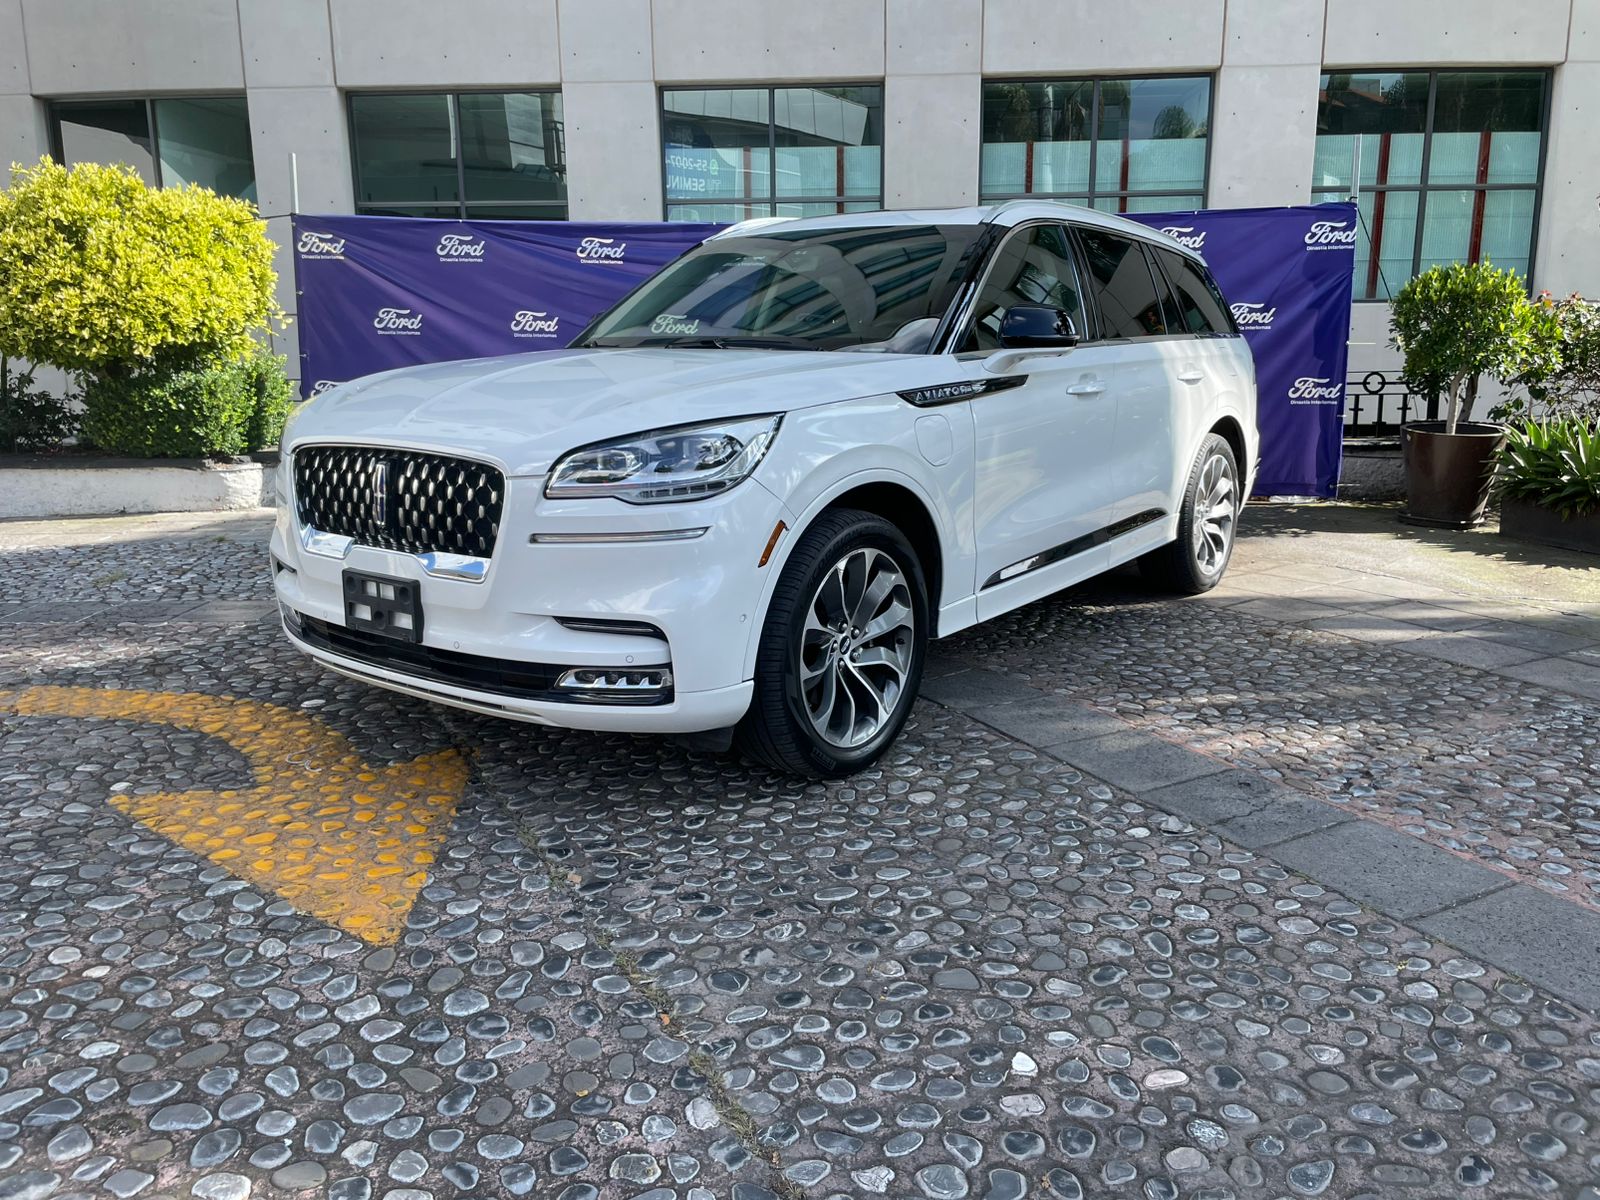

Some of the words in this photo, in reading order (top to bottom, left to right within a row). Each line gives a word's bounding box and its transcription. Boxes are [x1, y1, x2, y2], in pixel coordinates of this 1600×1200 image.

[1305, 221, 1357, 243] Ford
[298, 232, 345, 254] Ford
[437, 234, 485, 256] Ford
[577, 237, 626, 258] Ford
[374, 308, 422, 329] Ford
[511, 311, 559, 332] Ford
[651, 313, 699, 334] Ford
[1230, 303, 1276, 324] Ford
[916, 385, 968, 401] AVIATOR
[1288, 377, 1342, 398] Ford
